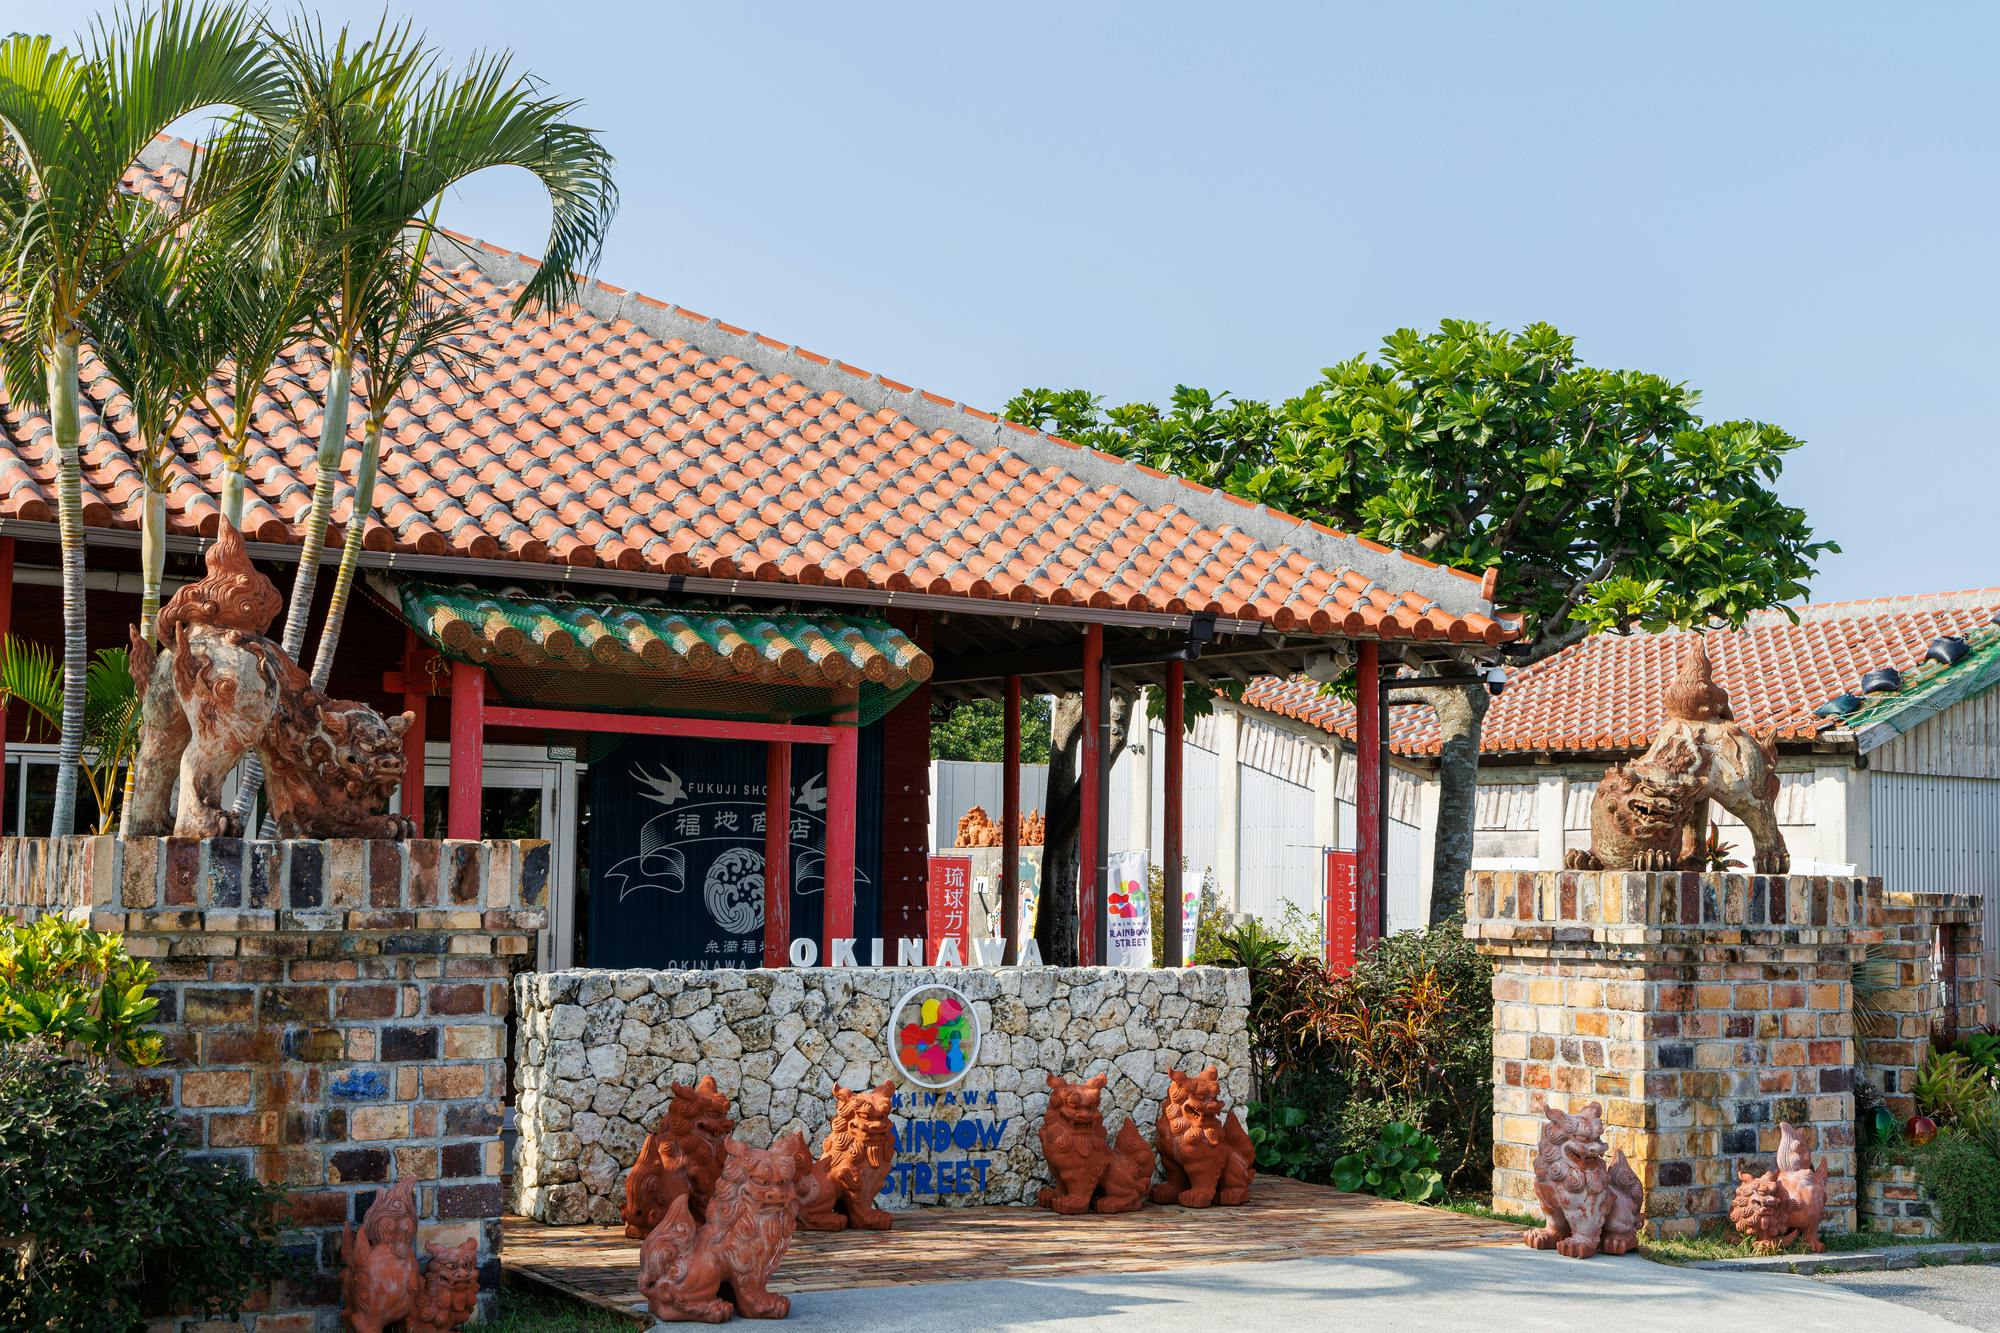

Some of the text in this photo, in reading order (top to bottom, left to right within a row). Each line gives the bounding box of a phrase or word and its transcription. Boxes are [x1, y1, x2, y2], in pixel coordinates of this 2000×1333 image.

[688, 782, 796, 797] FUKUJI SHON
[1109, 927, 1150, 939] RAINBOW
[1115, 938, 1147, 948] STREET
[789, 937, 1043, 967] OKINAWA
[890, 1089, 998, 1108] KINAWA
